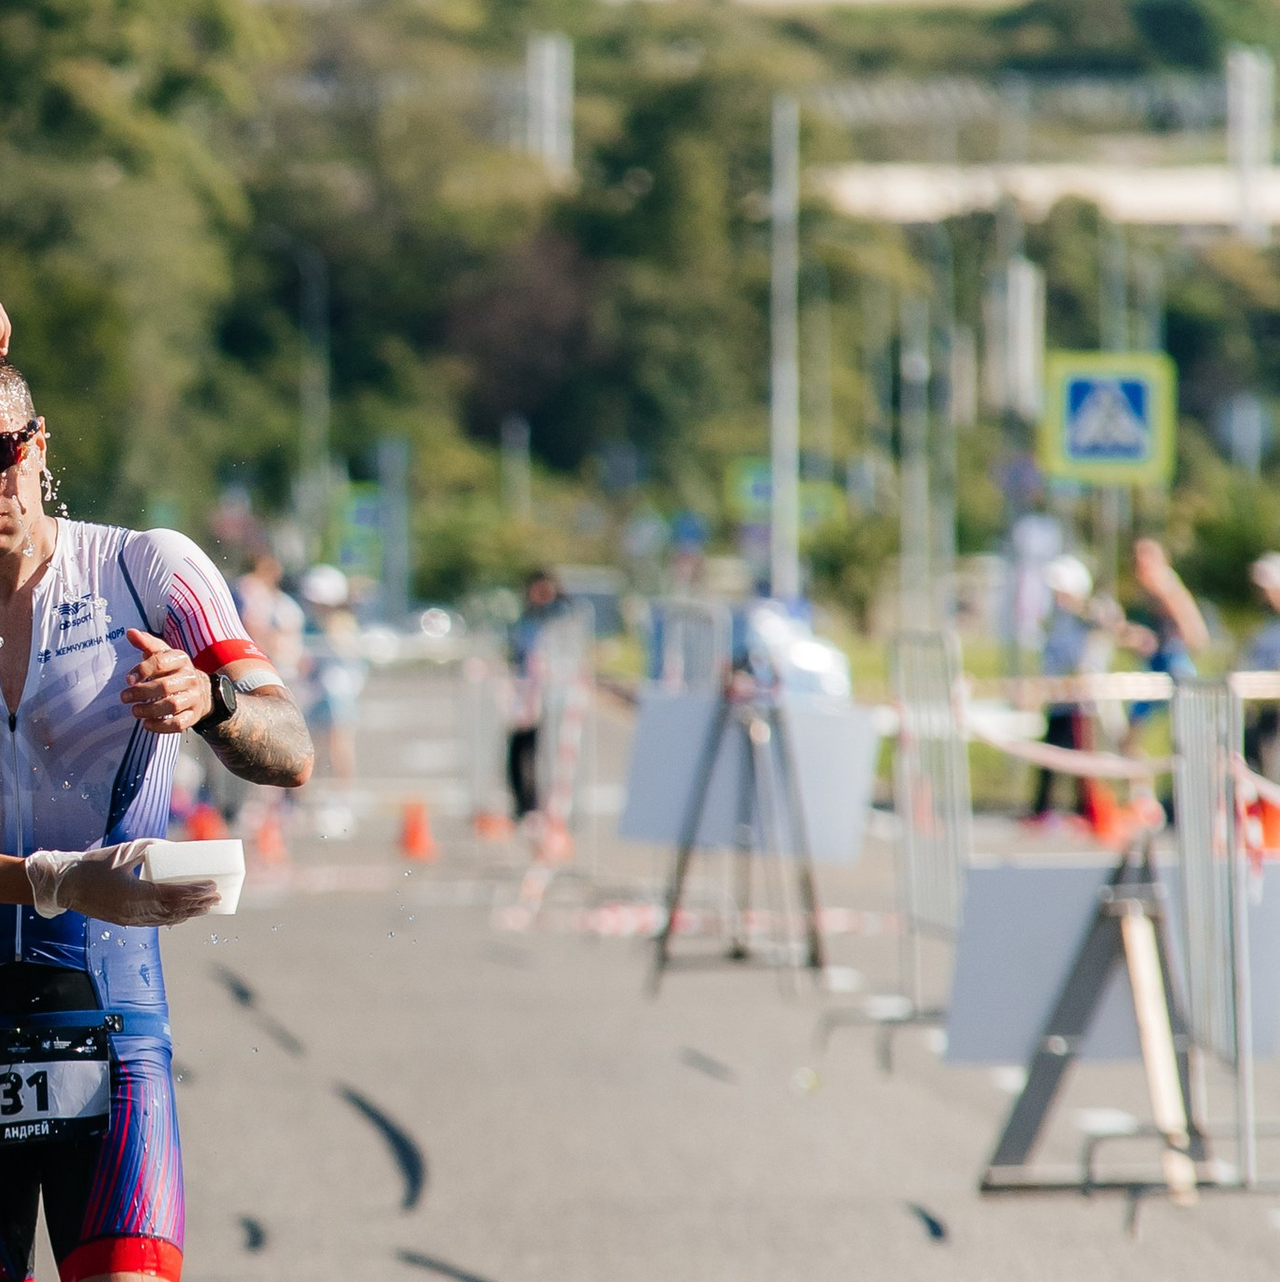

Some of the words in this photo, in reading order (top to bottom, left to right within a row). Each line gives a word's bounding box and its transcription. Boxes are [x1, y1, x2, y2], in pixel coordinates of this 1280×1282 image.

[55, 635, 104, 657] ЖЕМЧУЖИНА
[105, 626, 125, 643] МОРЯ
[4, 1120, 50, 1139] АНДРЕЙ
